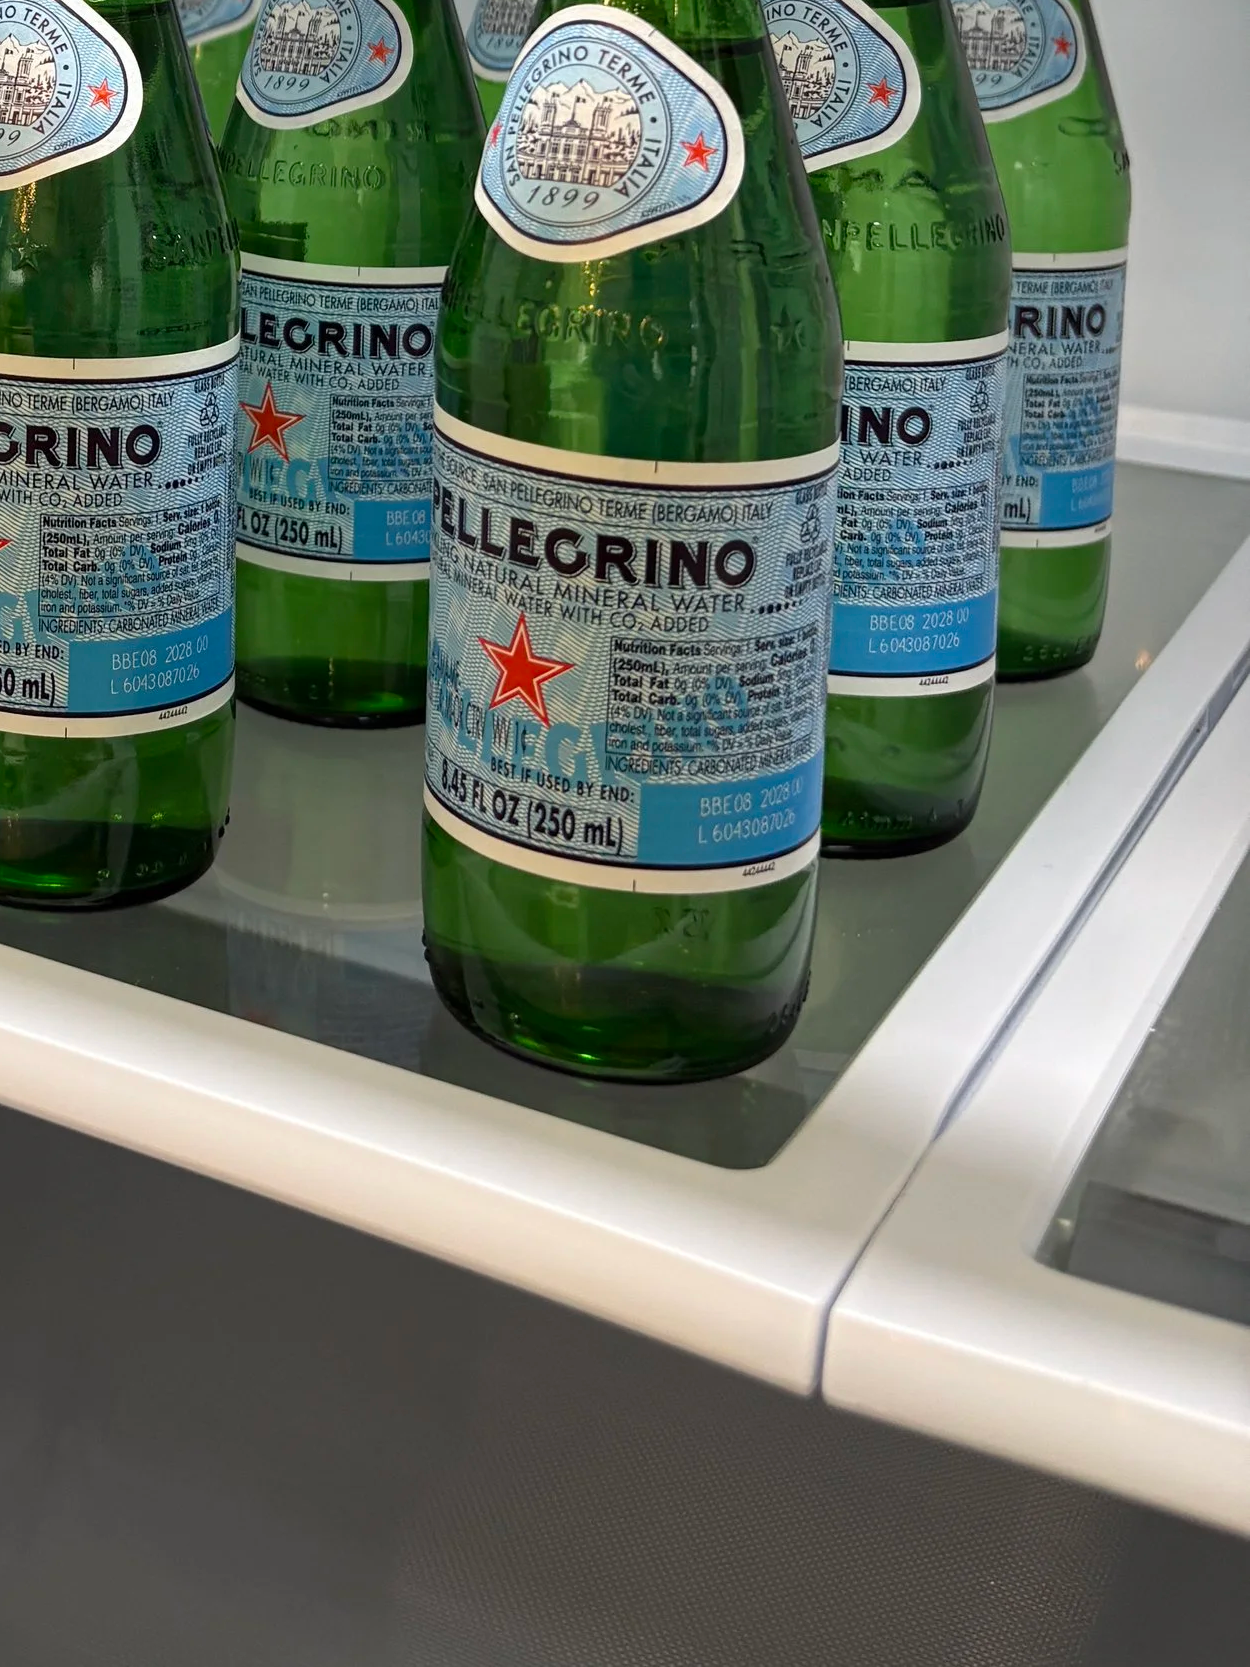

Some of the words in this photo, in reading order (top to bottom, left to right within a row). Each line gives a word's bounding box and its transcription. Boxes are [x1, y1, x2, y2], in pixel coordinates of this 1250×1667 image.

[23, 6, 68, 54] TERME
[801, 8, 849, 52] TERME
[319, 39, 355, 84] ITALIA
[1011, 34, 1041, 80] ITALIA
[262, 74, 311, 92] 1899
[507, 45, 590, 136] PELLEGRINO
[598, 50, 656, 105] TERME
[35, 83, 72, 135] ITALIA
[811, 78, 852, 129] ITALIA
[507, 146, 521, 187] SAN
[614, 137, 661, 198] ITALIA
[526, 185, 601, 210] 1899
[259, 287, 316, 307] PELLEGRINO
[320, 294, 354, 310] TERME
[357, 295, 420, 313] (BERGAMO)
[1061, 340, 1101, 354] WATER
[257, 365, 289, 384] WATER
[293, 371, 325, 388] WITH
[357, 377, 400, 391] ADDED
[289, 355, 365, 376] MINERAL
[371, 360, 427, 377] WATER
[844, 376, 916, 394] (BERGAMO)
[920, 376, 946, 391] ITALY
[26, 393, 69, 411] TERME
[71, 390, 145, 415] (BERGAMO)
[148, 390, 175, 409] ITALY
[860, 451, 922, 466] WATER
[89, 472, 154, 490] WATER
[842, 469, 892, 481] ADDED
[72, 493, 123, 508] ADDED
[249, 488, 268, 505] BEST
[282, 495, 305, 510] USED
[326, 501, 350, 516] END:
[483, 474, 506, 494] SAN
[510, 482, 593, 513] PELLEGRINO
[598, 497, 649, 521] TERME
[652, 500, 740, 526] (BERGAMO)
[741, 500, 774, 522] ITALY
[1004, 497, 1031, 524] mL)
[42, 516, 87, 528] Nutrition
[89, 517, 117, 528] Facts
[250, 512, 269, 534] OZ
[274, 517, 309, 546] (250
[314, 525, 343, 554] mL)
[42, 533, 89, 545] (250mL),
[42, 546, 68, 558] Total
[73, 547, 91, 558] Fat
[42, 560, 68, 572] Total
[72, 561, 100, 572] Carb.
[464, 556, 546, 596] NATURAL
[553, 584, 662, 614] MINERAL
[671, 593, 746, 614] WATER
[454, 570, 499, 601] MINERAL
[504, 589, 551, 616] WATER
[560, 604, 603, 628] WITH
[651, 614, 710, 633] ADDED
[922, 610, 954, 631] 2028
[15, 642, 30, 656] BY
[35, 644, 64, 659] END:
[166, 642, 193, 663] 2028
[196, 636, 209, 652] 00
[22, 673, 56, 706] mL)
[159, 706, 188, 721] 44244442
[490, 757, 516, 779] BEST
[521, 767, 530, 784] IF
[536, 773, 570, 793] USED
[576, 780, 594, 797] BY
[600, 784, 635, 802] END:
[761, 785, 790, 807] 2028
[472, 780, 486, 813] FL
[491, 789, 521, 825] OZ
[527, 800, 576, 841] (250
[583, 817, 624, 855] mL)
